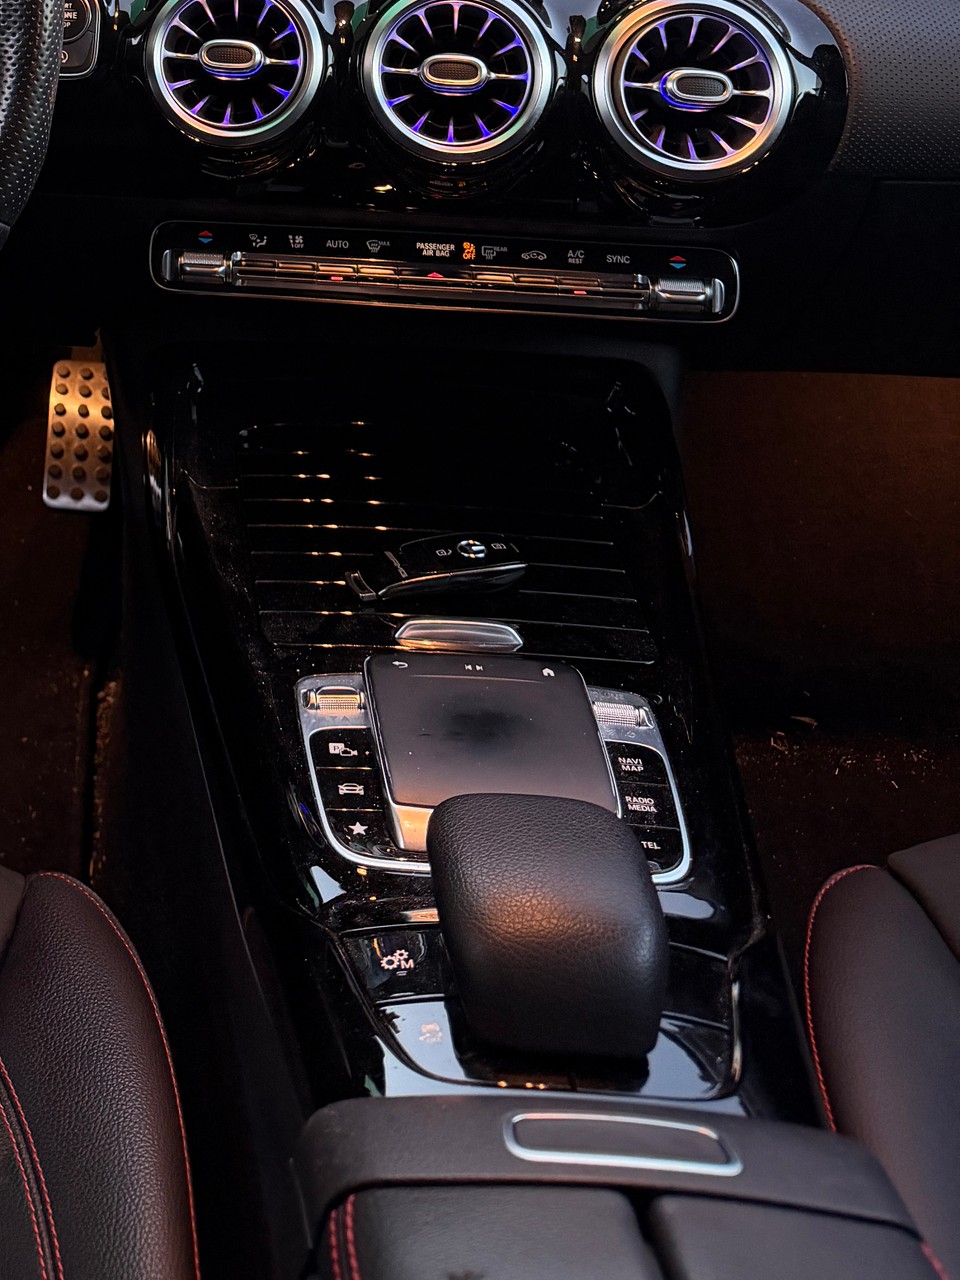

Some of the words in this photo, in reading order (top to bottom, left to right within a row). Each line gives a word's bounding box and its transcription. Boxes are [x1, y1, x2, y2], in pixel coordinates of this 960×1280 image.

[326, 240, 350, 249] AUTO
[416, 242, 455, 252] PASSENGER
[436, 250, 450, 258] BAG
[568, 250, 585, 259] A/C
[606, 254, 630, 264] SYNC
[618, 757, 643, 765] NAVI
[624, 796, 655, 805] RADIO
[628, 804, 658, 813] MEDIA
[640, 840, 662, 850] TEL
